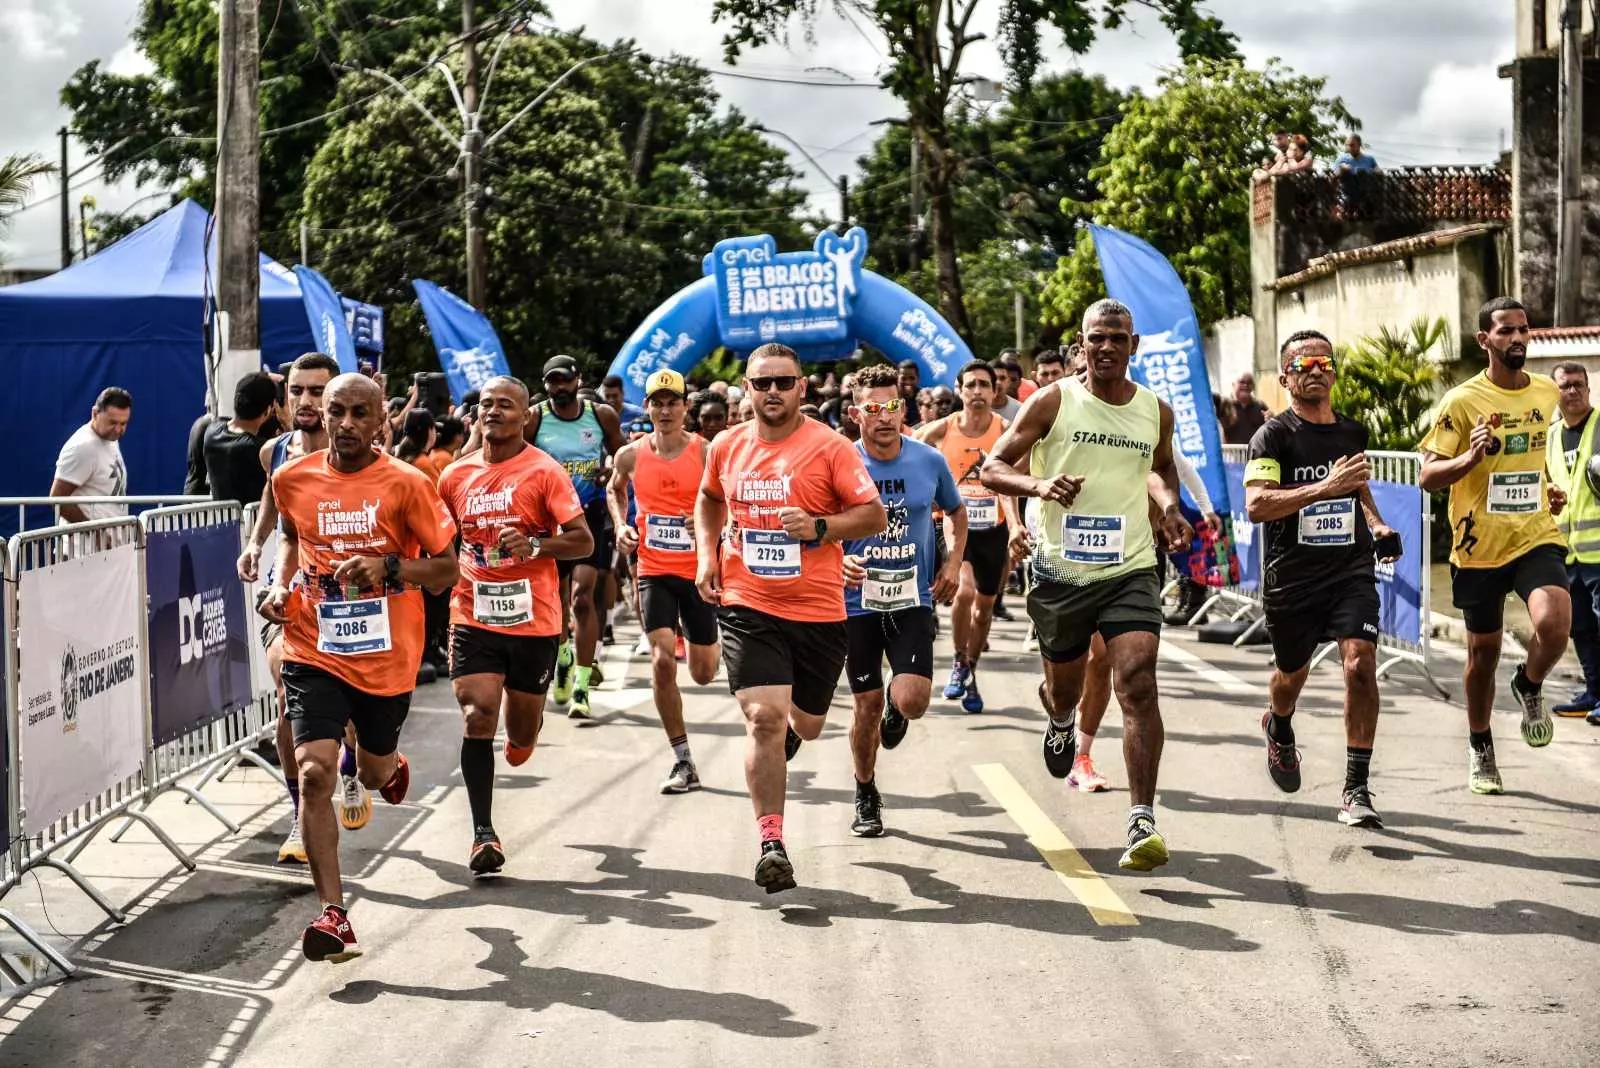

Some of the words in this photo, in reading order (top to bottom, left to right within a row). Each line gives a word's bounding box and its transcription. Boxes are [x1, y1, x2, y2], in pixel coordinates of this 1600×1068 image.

[722, 242, 771, 265] enel
[742, 283, 836, 314] ABERTOS
[1164, 349, 1206, 453] ABERTOS
[1072, 431, 1107, 446] STAR
[743, 490, 784, 501] ABERTOS
[1506, 487, 1529, 499] 1215
[317, 499, 341, 511] enel
[325, 522, 368, 536] ABERTOS
[1316, 517, 1343, 530] 2085
[658, 528, 681, 539] 2388
[1078, 533, 1107, 547] 2123
[757, 547, 785, 561] 2729
[863, 543, 916, 560] CORRER
[490, 599, 515, 612] 1158
[335, 620, 368, 637] 2086
[79, 672, 94, 702] RIO
[94, 667, 105, 695] DE
[105, 654, 135, 690] JANEIRO
